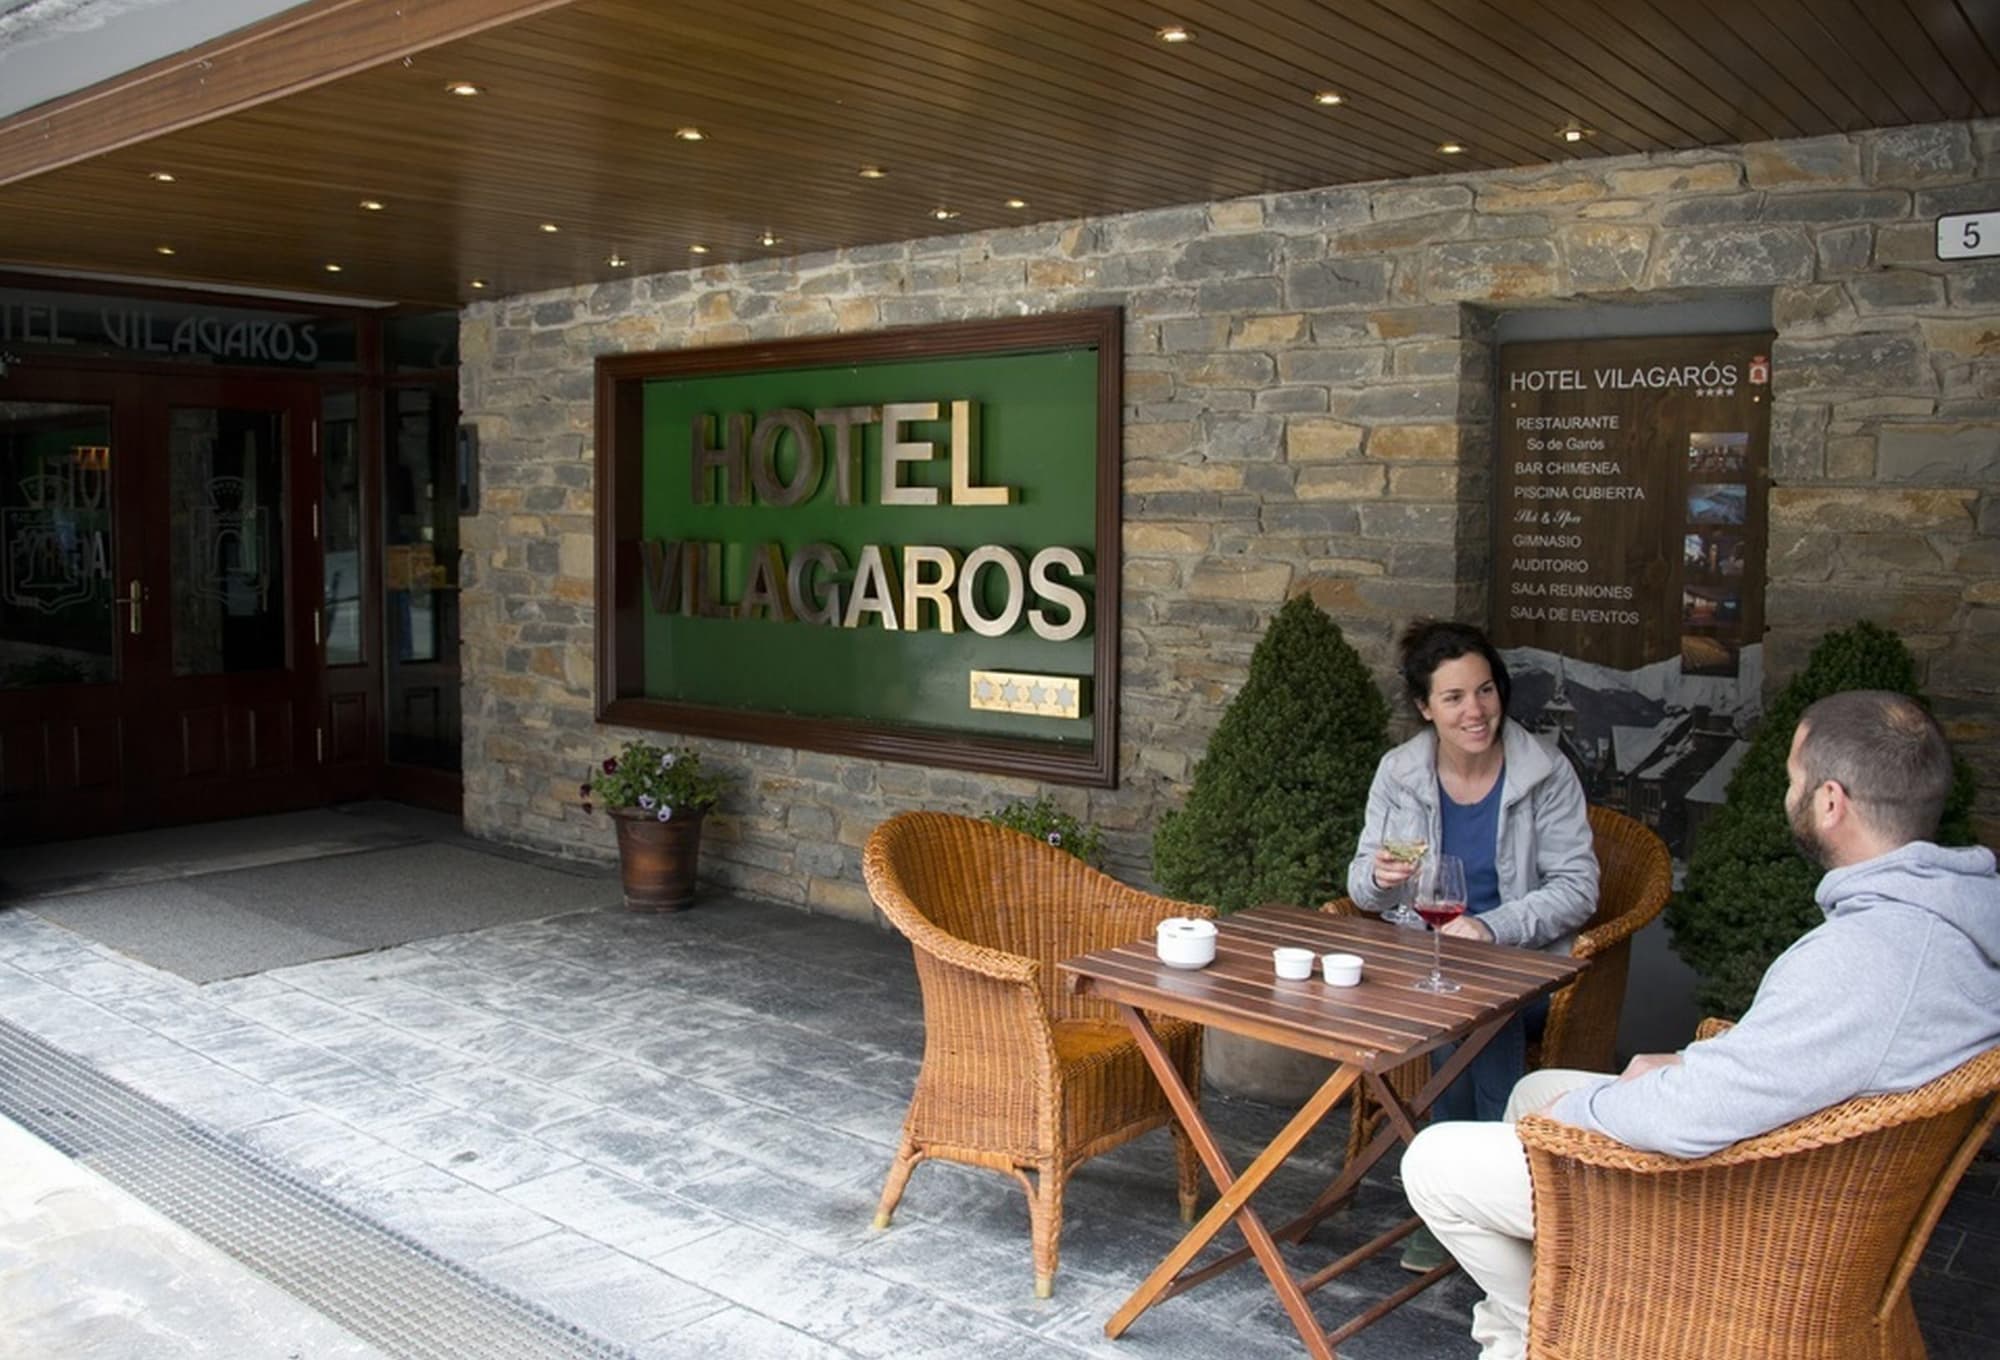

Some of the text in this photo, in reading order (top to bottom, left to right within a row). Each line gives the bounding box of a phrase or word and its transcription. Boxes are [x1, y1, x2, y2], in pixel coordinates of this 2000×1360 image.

[1963, 221, 1981, 250] 5
[1511, 361, 1738, 391] HOTEL VILAGARÓS
[1516, 416, 1620, 430] RESTAURANTE
[1527, 436, 1605, 451] So de Garós
[691, 400, 1018, 507] HOTEL
[1515, 462, 1620, 475] BAR CHIMENEA
[1514, 486, 1645, 500] PISCINA CUBIERTA
[1541, 511, 1550, 524] &
[1512, 535, 1582, 549] GIMNASIO
[1511, 559, 1589, 573] AUDITORIO
[641, 540, 1092, 642] VILAGAROS
[1511, 583, 1633, 599] SALA REUNIONES
[1510, 606, 1640, 624] SALA DE EVENTOS
